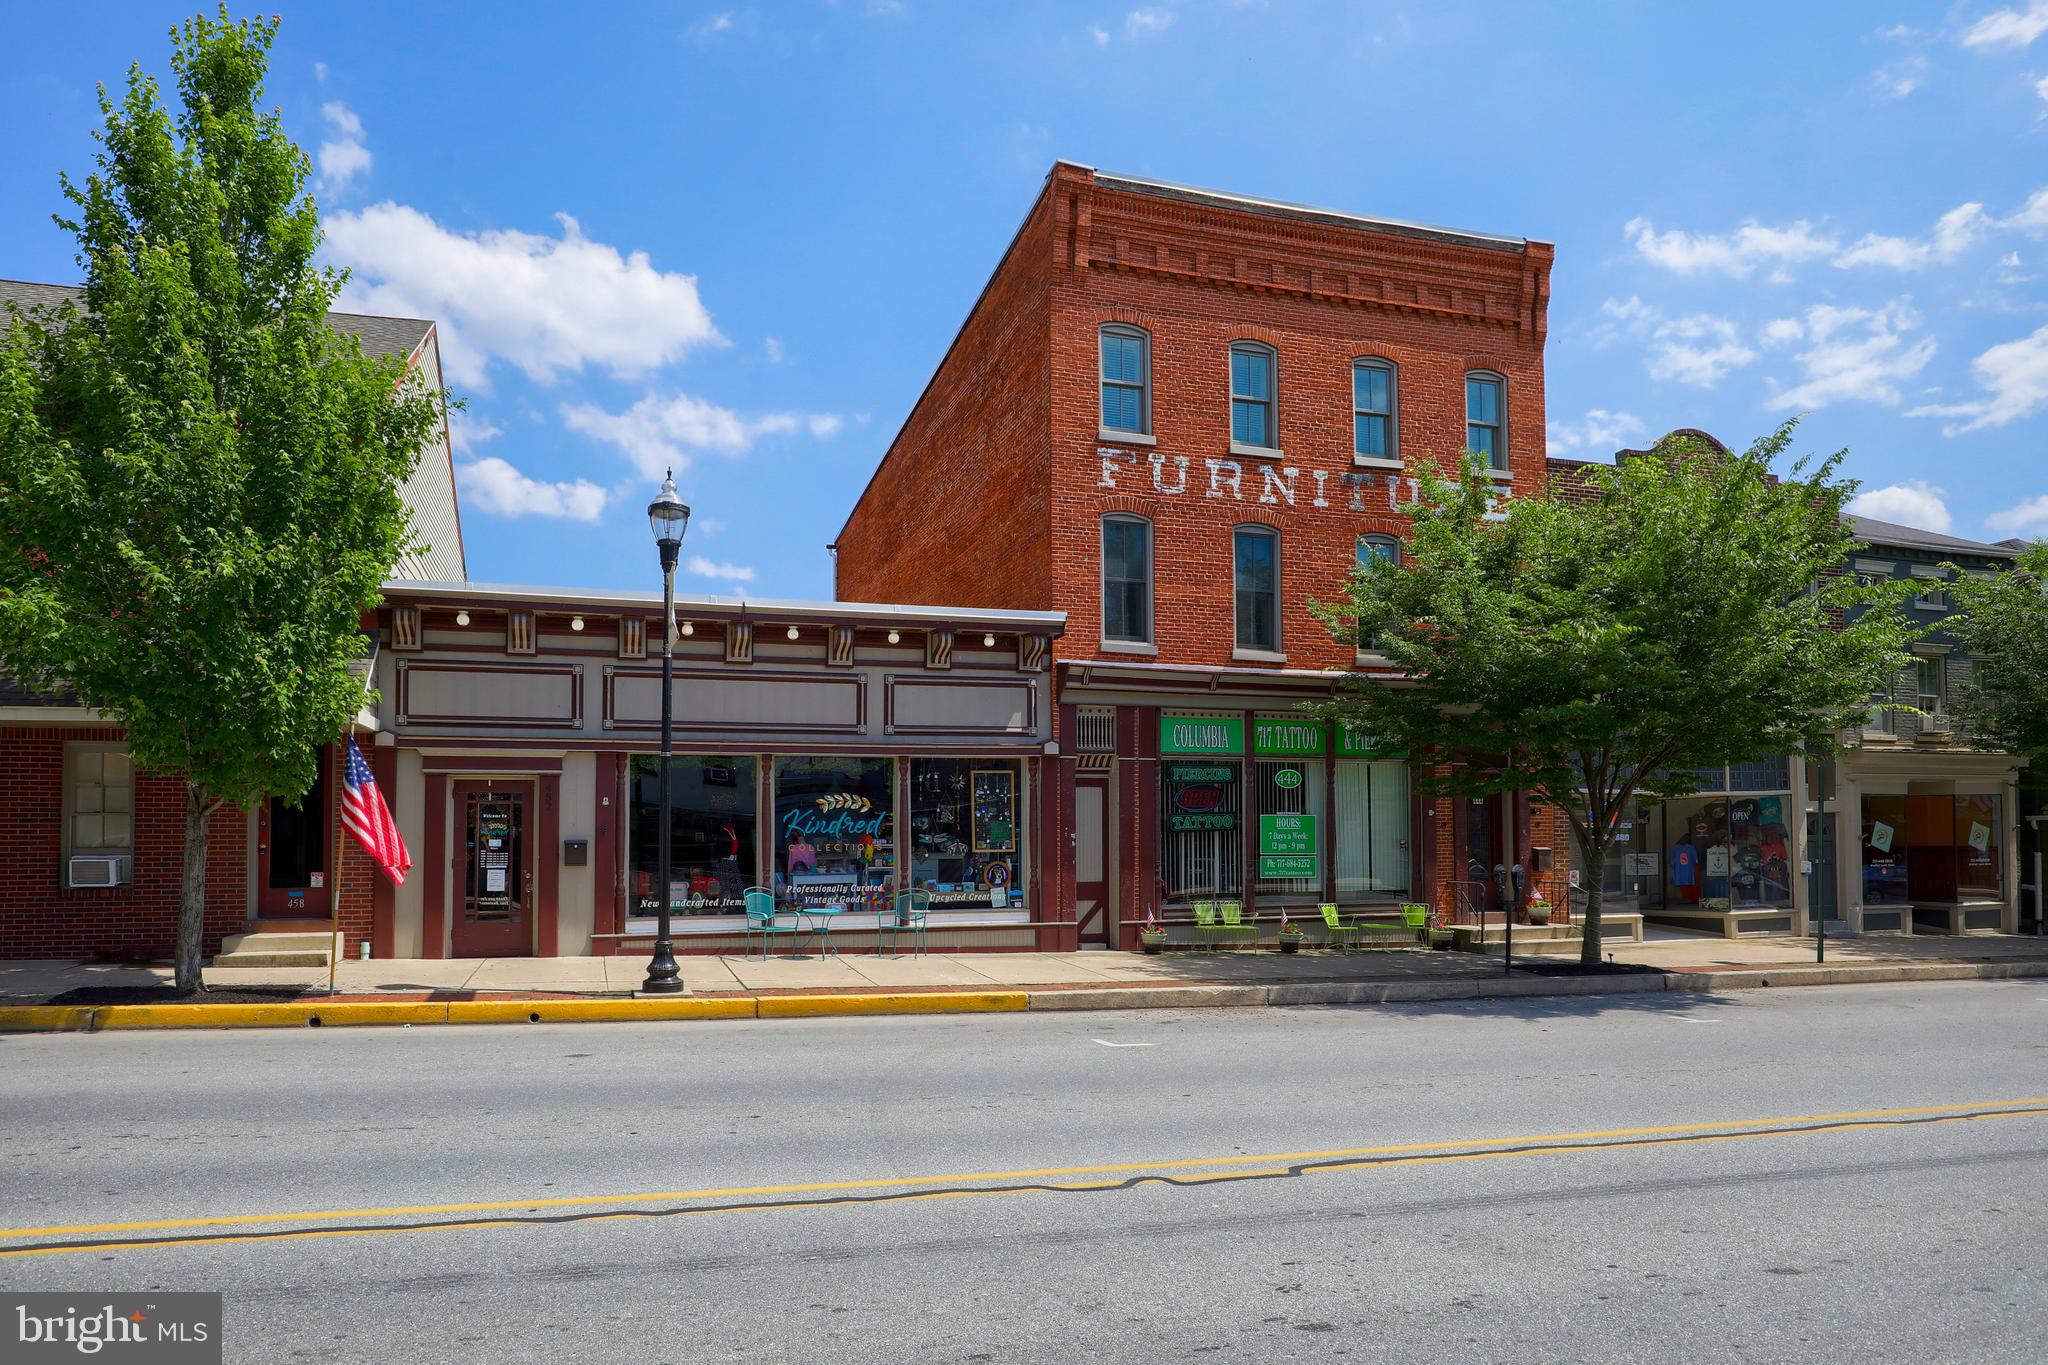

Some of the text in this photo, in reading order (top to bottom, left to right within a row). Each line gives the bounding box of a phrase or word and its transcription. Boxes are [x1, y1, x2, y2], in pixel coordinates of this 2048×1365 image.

[1173, 724, 1229, 748] COLUMBIA
[1257, 726, 1272, 748] 717
[1275, 726, 1317, 750] TATTOO
[1278, 773, 1298, 784] 444
[783, 809, 886, 839] Kindred
[1171, 815, 1233, 829] TATTOO
[1276, 818, 1301, 828] HOURS:
[786, 884, 883, 894] Professionally Curated
[805, 895, 865, 904] Vintage Goods
[930, 892, 966, 902] Upcycled
[288, 898, 305, 908] 458
[640, 899, 659, 908] New
[669, 899, 719, 909] andcrafted
